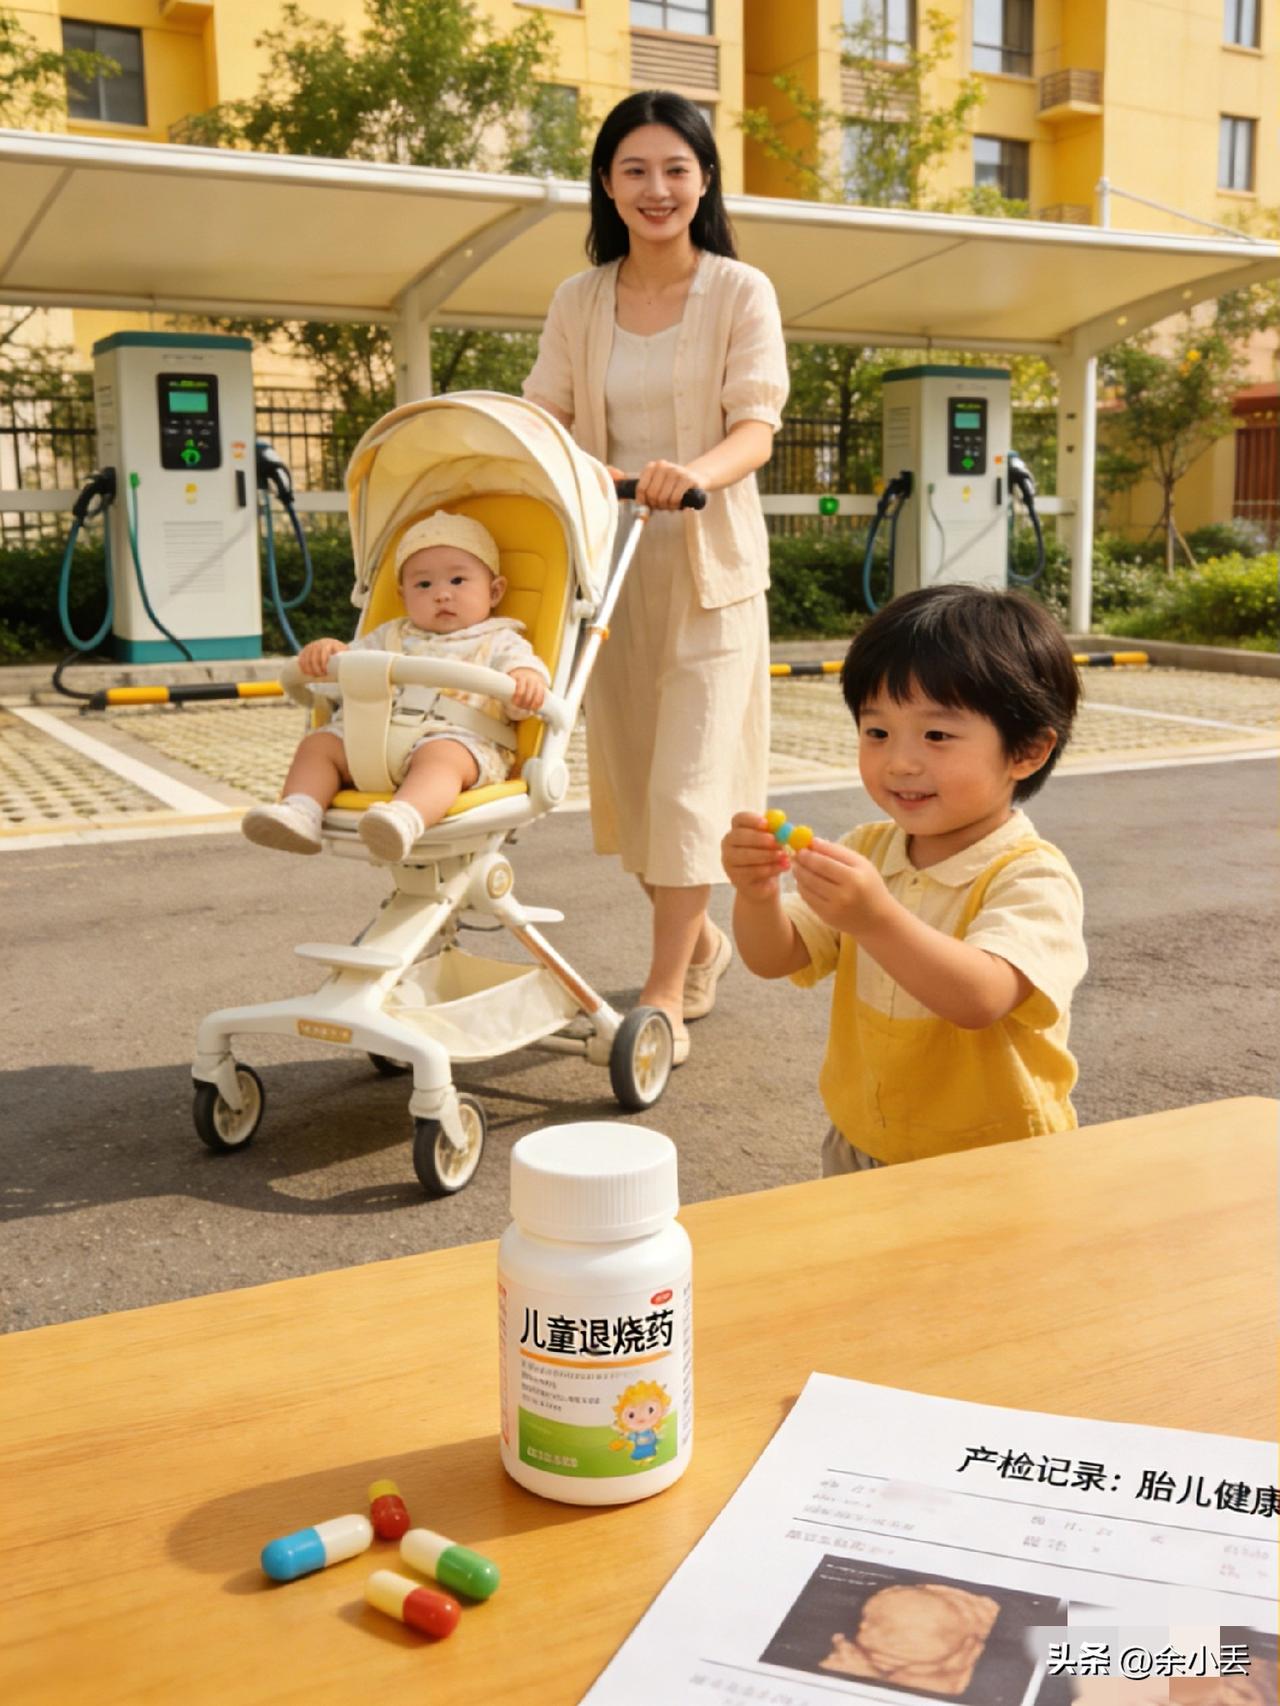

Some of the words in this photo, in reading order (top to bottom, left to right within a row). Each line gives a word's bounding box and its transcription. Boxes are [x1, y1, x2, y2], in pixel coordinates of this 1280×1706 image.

[520, 1307, 674, 1355] 儿童退烧药
